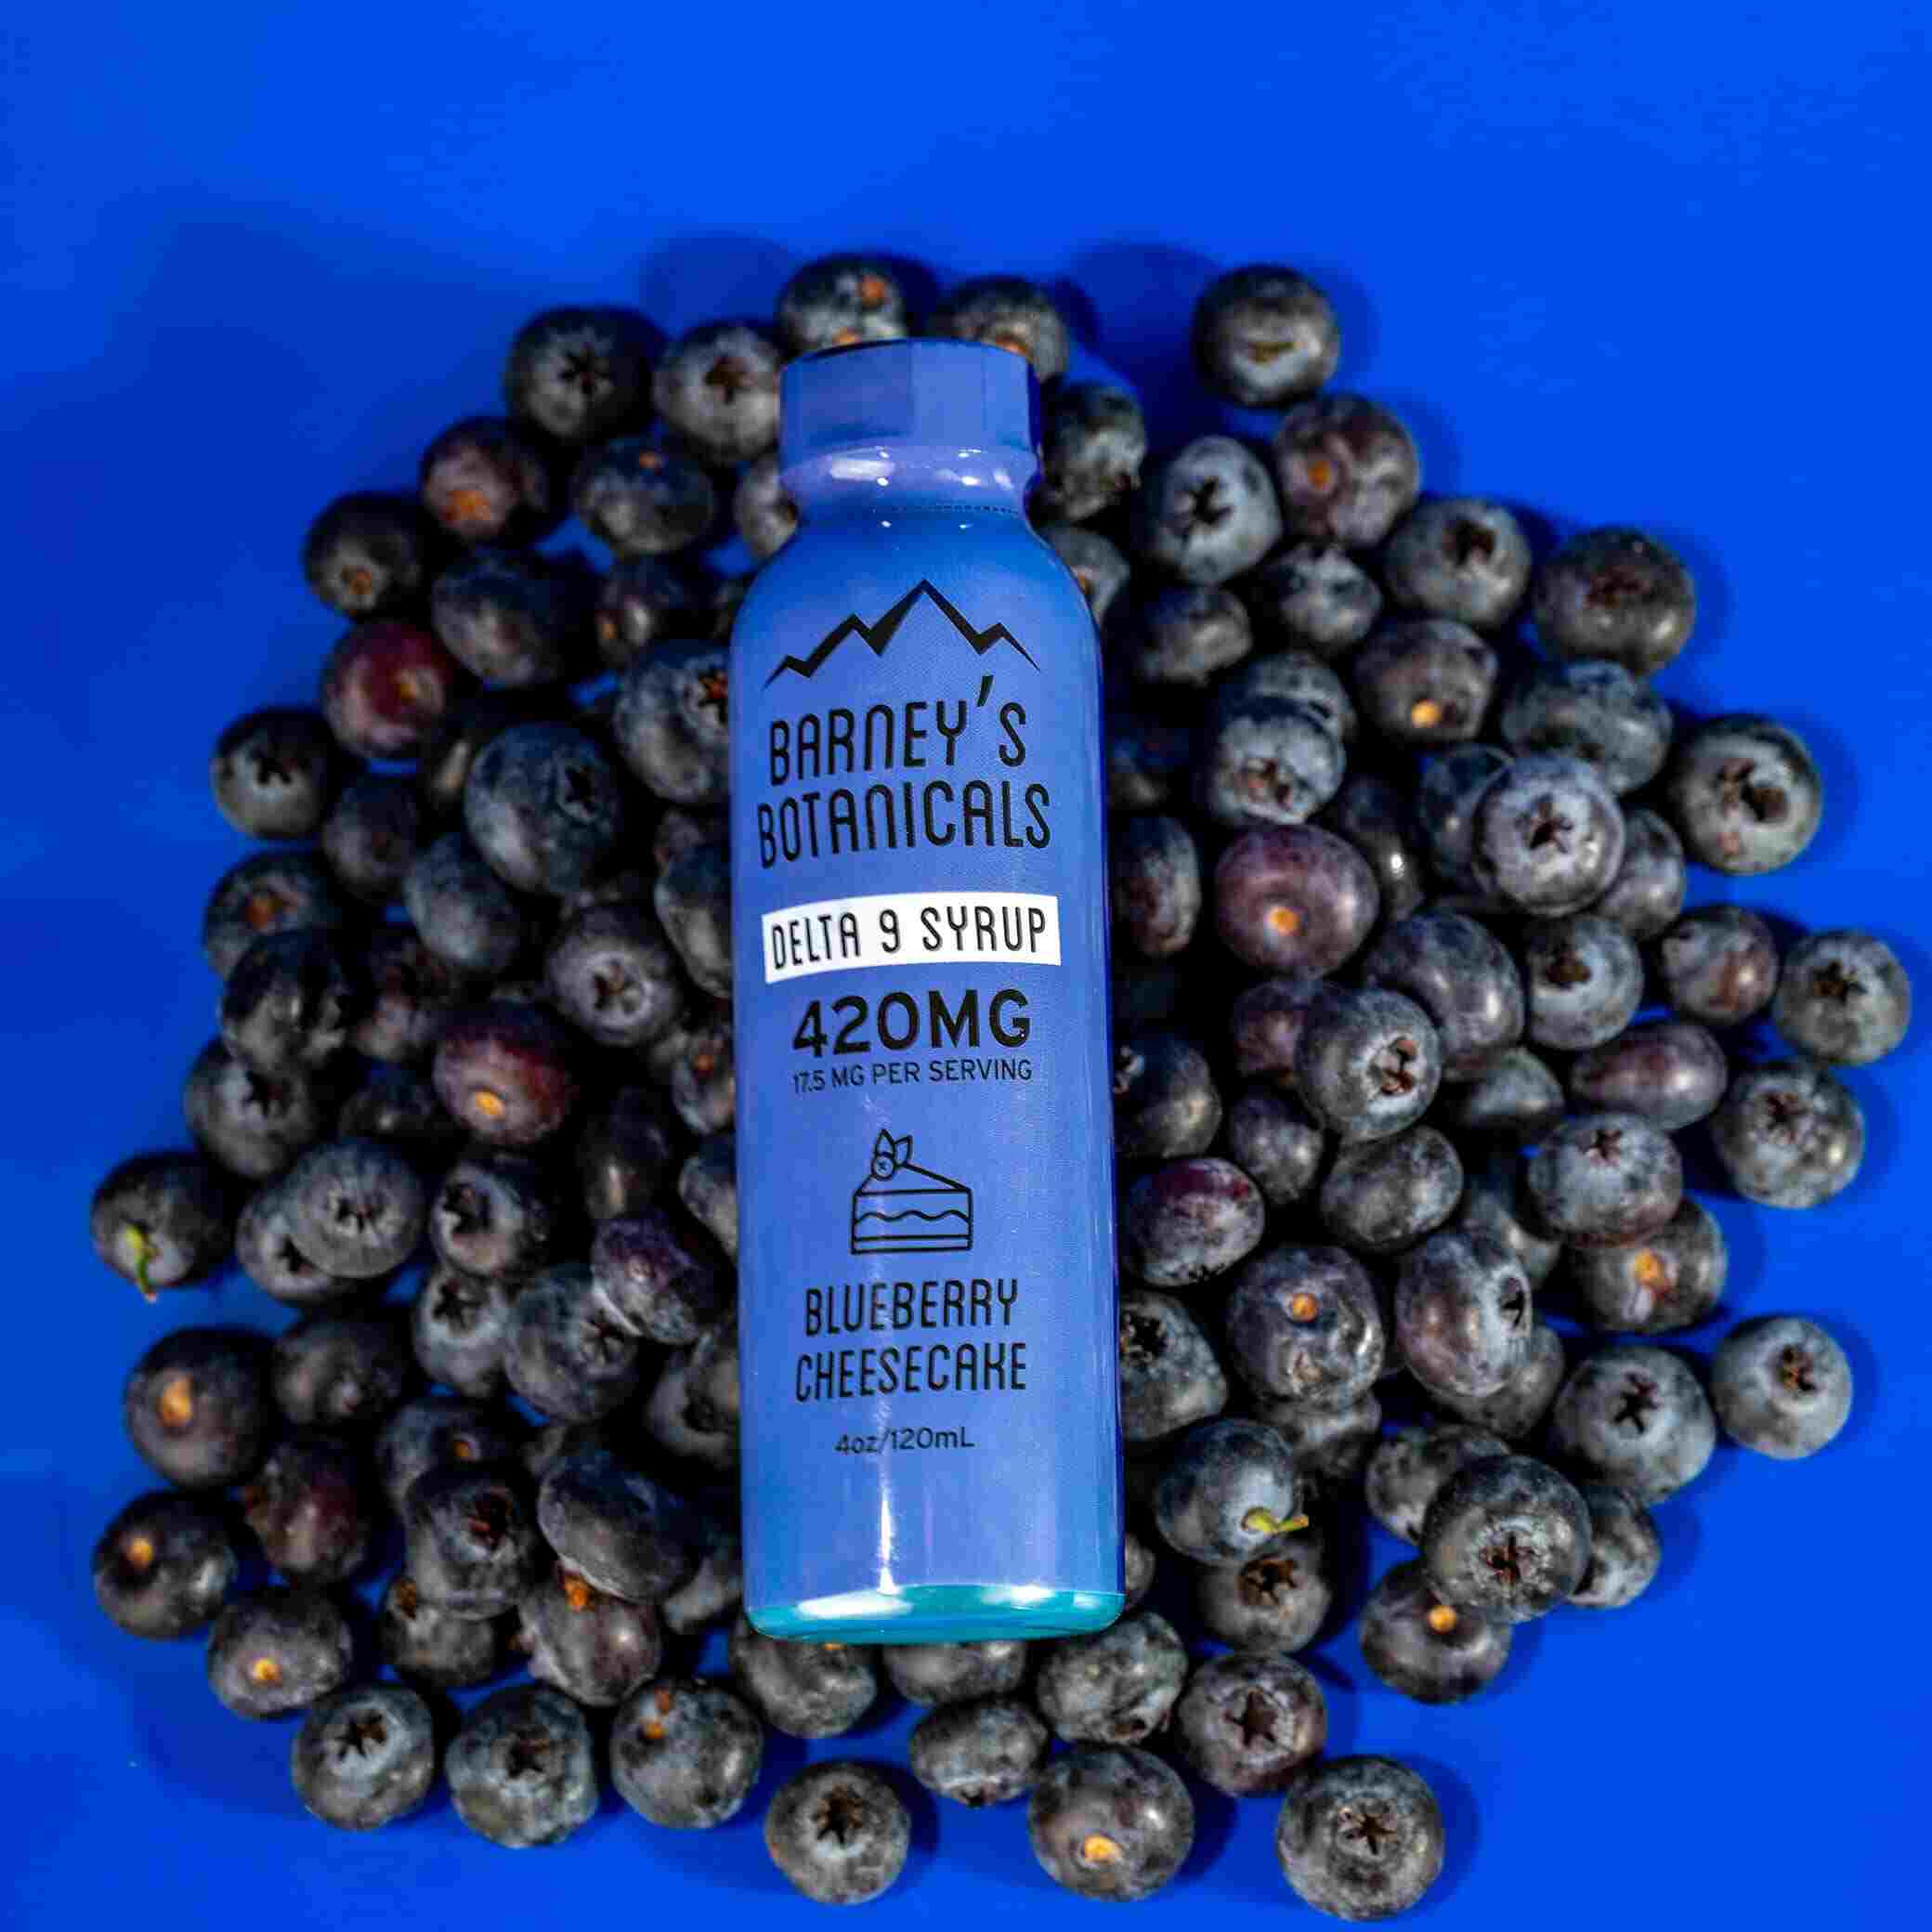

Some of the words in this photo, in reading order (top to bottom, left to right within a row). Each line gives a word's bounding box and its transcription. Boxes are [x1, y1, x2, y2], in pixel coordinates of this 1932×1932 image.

[768, 674, 1027, 788] BARNEY'S
[757, 778, 1052, 869] BOTANICALS
[771, 912, 860, 971] DELTA
[878, 907, 901, 954] 9
[920, 905, 1047, 954] SYRUP
[791, 987, 1032, 1059] 420MG
[791, 1068, 827, 1093] 17.5
[830, 1064, 864, 1088] MG
[871, 1062, 921, 1086] PER
[929, 1058, 1033, 1083] SERVING
[803, 1277, 1019, 1338] BLUEBERRY
[794, 1342, 1027, 1403] CHEESECAKE
[834, 1425, 975, 1456] 4oz/120mL
